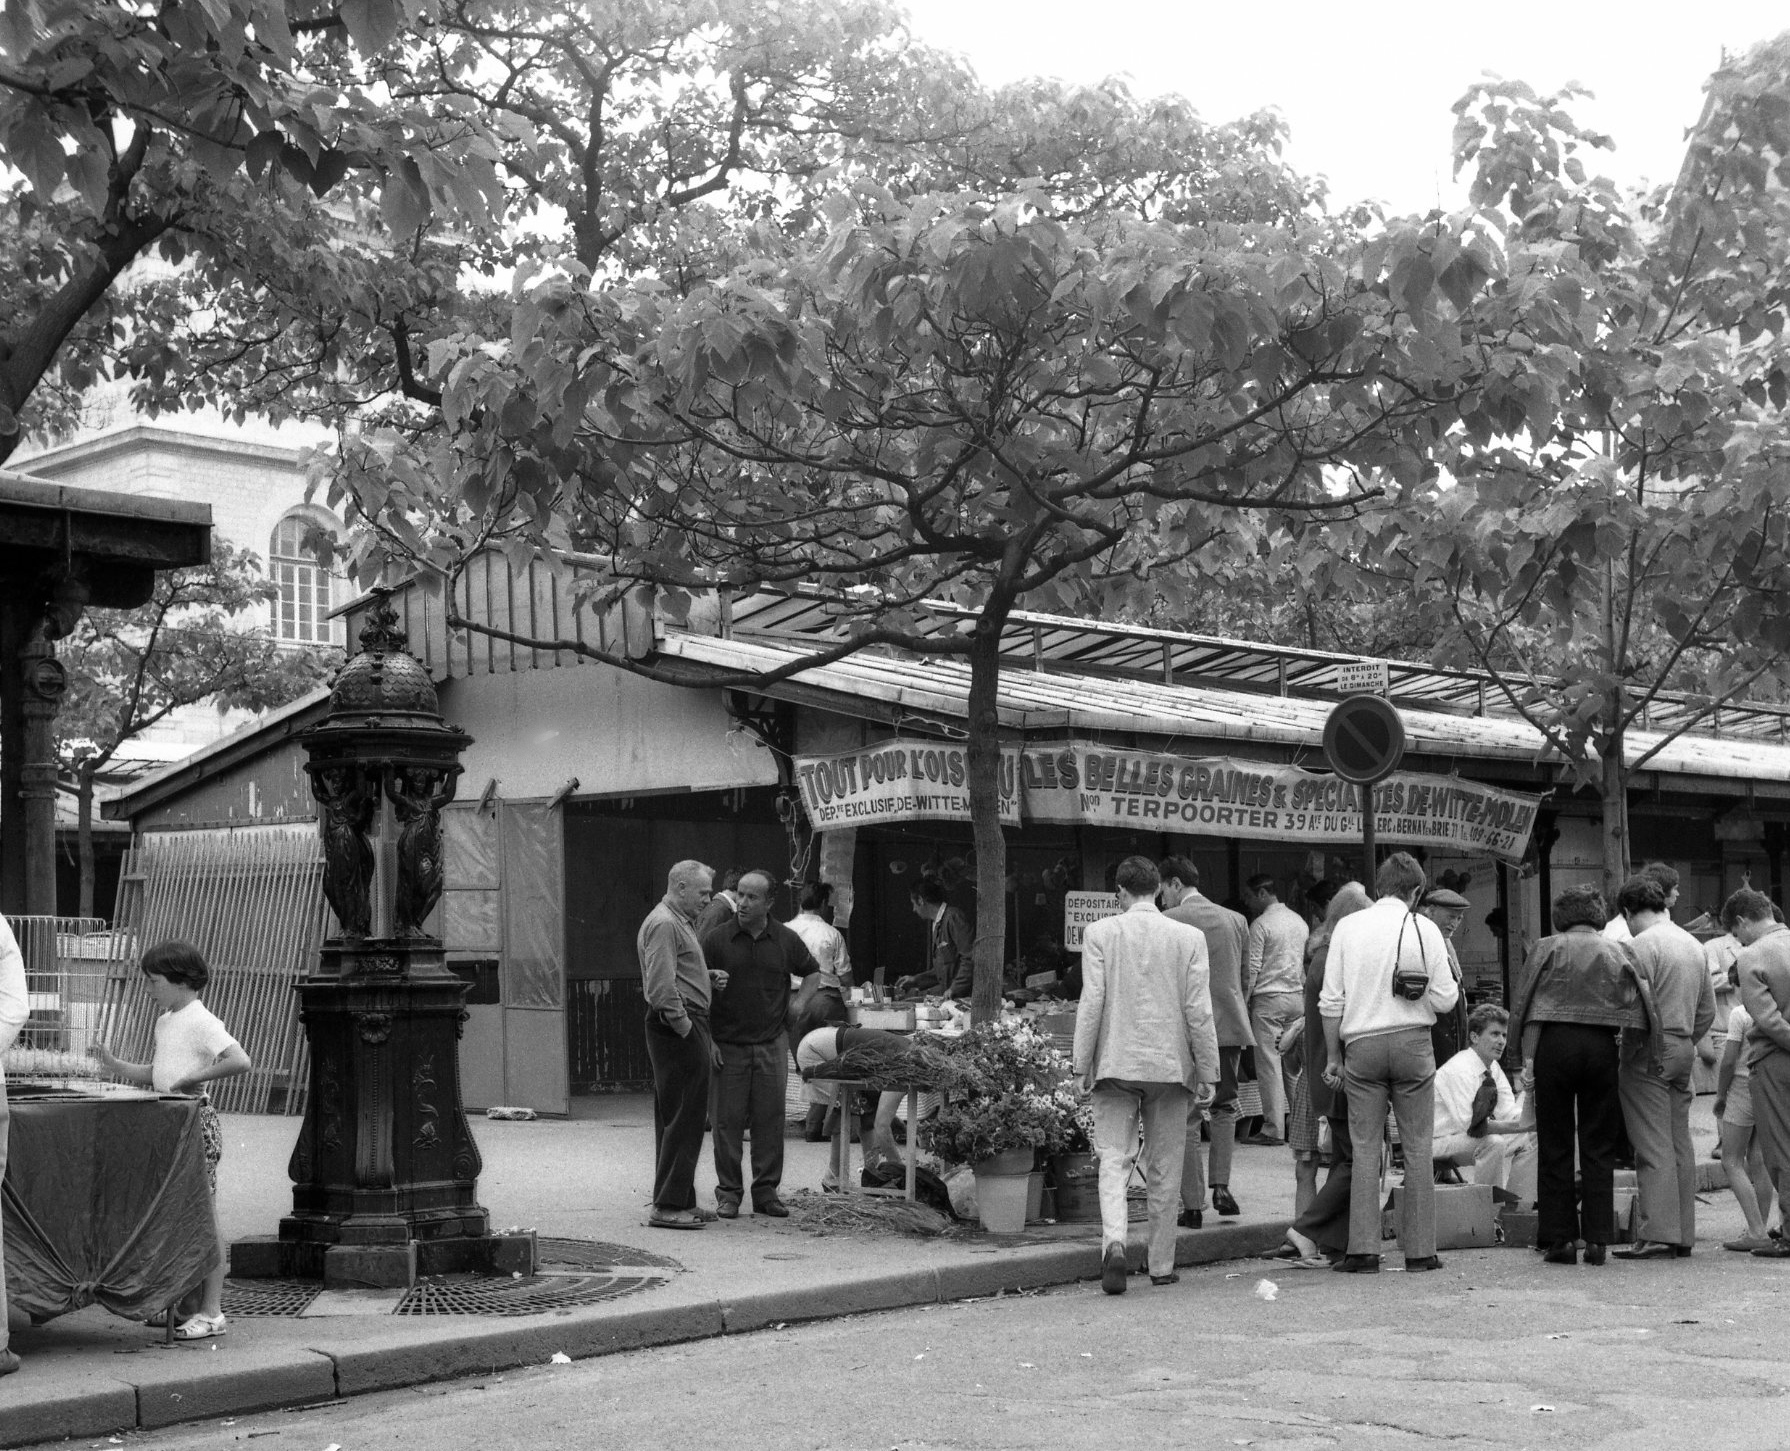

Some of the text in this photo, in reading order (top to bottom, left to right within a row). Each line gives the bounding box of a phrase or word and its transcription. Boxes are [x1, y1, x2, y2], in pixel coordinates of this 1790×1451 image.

[1343, 665, 1380, 673] INTERDIT
[1350, 680, 1384, 689] DIMANCHE
[801, 749, 1014, 811] TOUT POUR L'OISU
[1022, 752, 1080, 790] LES
[1085, 755, 1174, 797] BELLES
[1178, 766, 1274, 808] GRAINES
[1273, 784, 1287, 809] &
[1291, 779, 1404, 813] SPECIATES
[845, 798, 894, 818] EXCLUSIF
[1111, 797, 1278, 829] TERPOORTER
[1284, 813, 1306, 830] 39
[1324, 815, 1337, 832] DU
